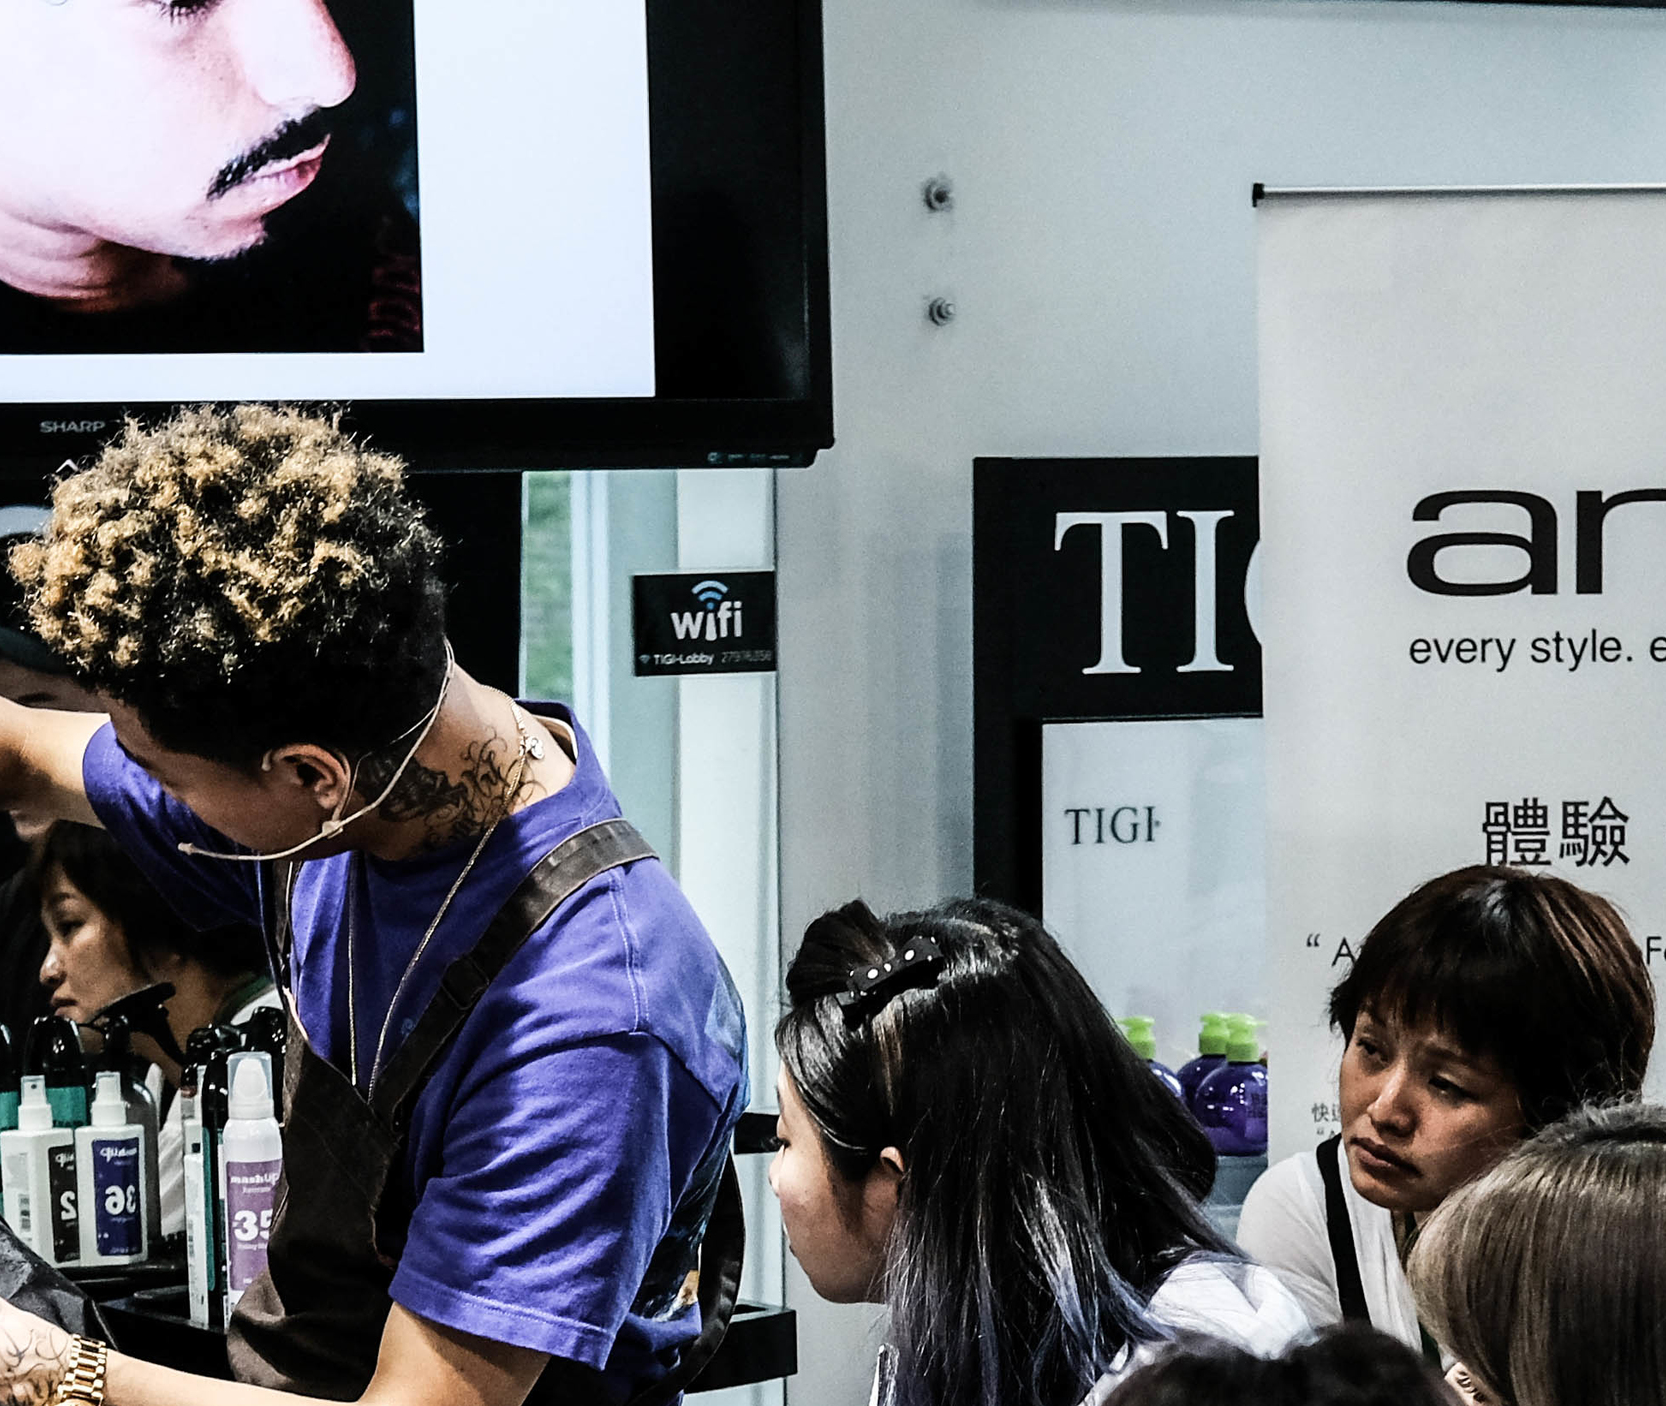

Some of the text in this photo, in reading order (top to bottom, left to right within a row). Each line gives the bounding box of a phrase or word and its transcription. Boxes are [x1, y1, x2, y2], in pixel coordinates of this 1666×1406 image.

[39, 420, 106, 433] SHARP
[1054, 509, 1262, 674] TI
[670, 600, 742, 642] wifi
[1409, 637, 1517, 673] every
[1530, 627, 1633, 673] style.
[231, 1208, 273, 1242] 35
